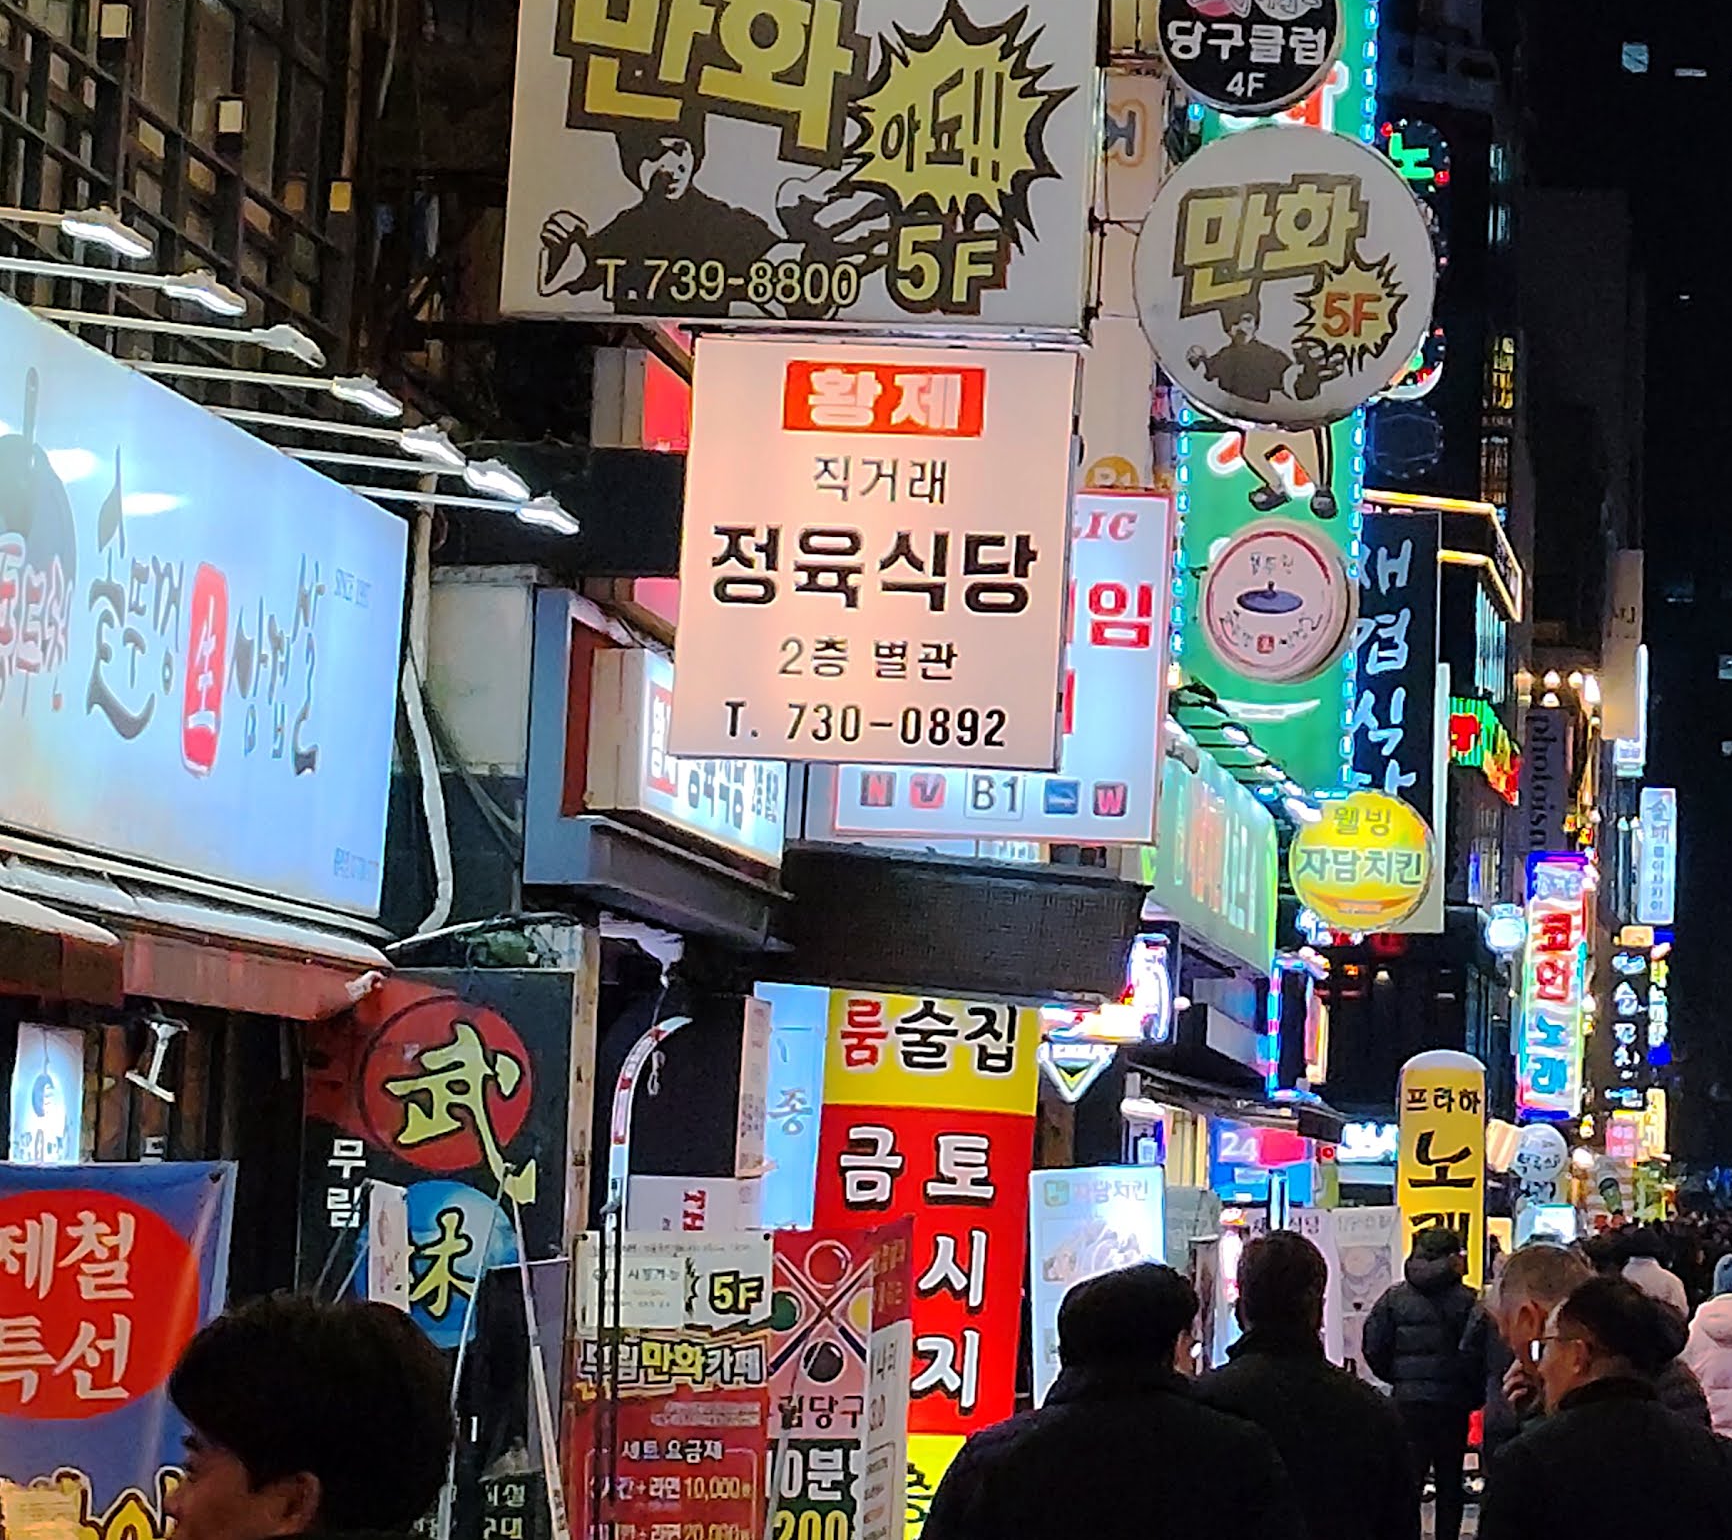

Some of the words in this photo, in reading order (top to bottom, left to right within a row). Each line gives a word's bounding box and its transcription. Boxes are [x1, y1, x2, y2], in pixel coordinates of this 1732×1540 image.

[1168, 20, 1327, 65] 당구클럽
[1225, 72, 1266, 99] 4F
[896, 223, 1001, 304] 5F
[1183, 183, 1359, 305] 만화
[594, 258, 860, 305] T.739-8800
[1320, 291, 1382, 338] 5F
[807, 368, 964, 432] 황제
[813, 456, 949, 505] 직거래
[711, 524, 1040, 615] 정육식당
[778, 638, 849, 678] 2층
[873, 640, 958, 682] 별관
[723, 700, 759, 741] T.
[787, 702, 1009, 749] 730-0892
[971, 773, 1020, 814] B1
[1333, 808, 1392, 837] 웰빙
[1297, 848, 1424, 888] 자담치킨
[840, 998, 1020, 1074] 룸술집
[1406, 1087, 1482, 1114] 프라하
[1219, 1132, 1260, 1164] 24
[327, 1137, 367, 1231] 무림
[708, 1270, 764, 1316] 5F
